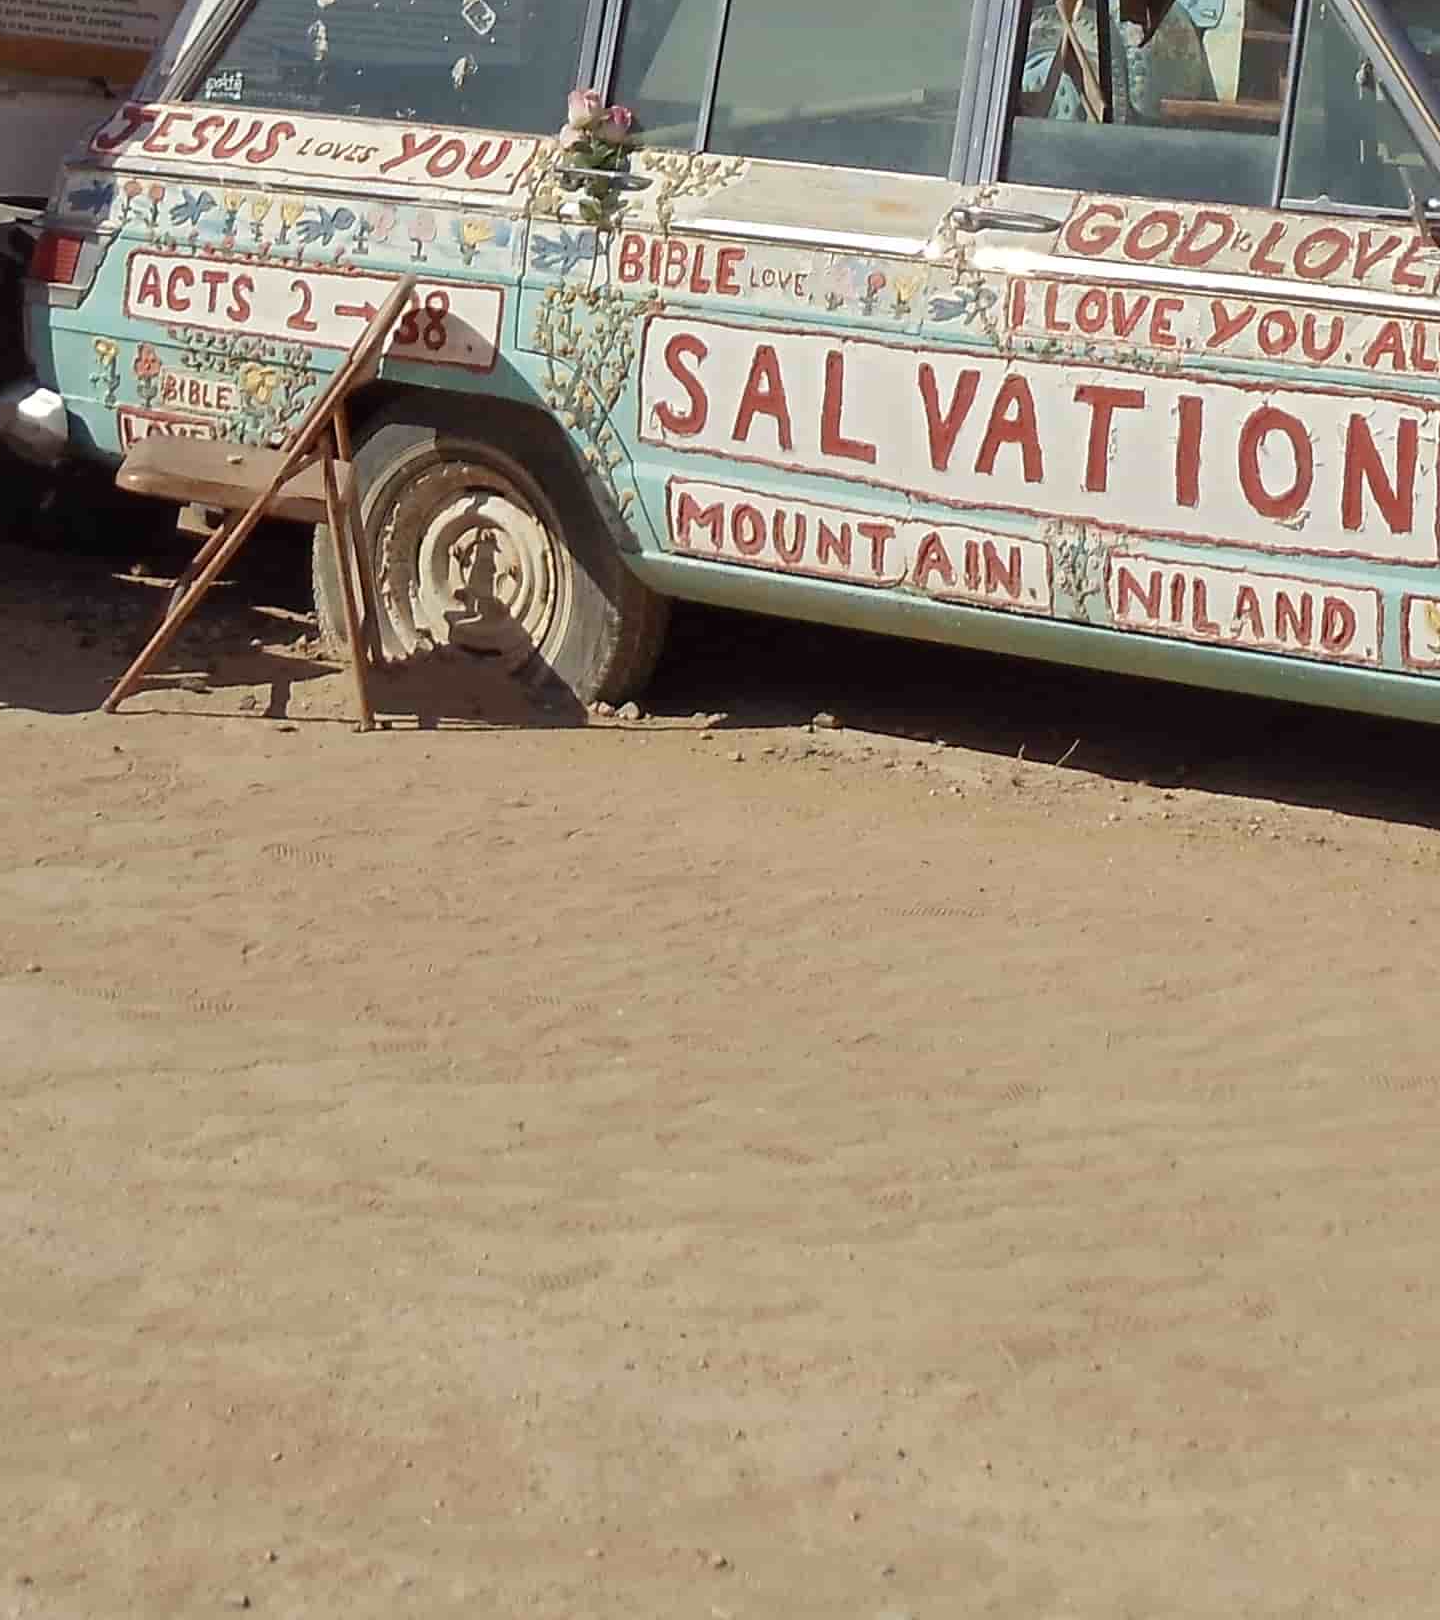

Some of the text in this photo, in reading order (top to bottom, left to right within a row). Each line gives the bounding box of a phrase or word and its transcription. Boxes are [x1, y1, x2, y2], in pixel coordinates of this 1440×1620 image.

[93, 102, 296, 166] JESUS
[296, 135, 380, 166] LOVES
[618, 233, 747, 295] BIBLE
[1064, 203, 1235, 269] GOD
[136, 264, 451, 352] ACTS 2 38
[1010, 278, 1027, 329] I
[656, 331, 1420, 536] SALVATION
